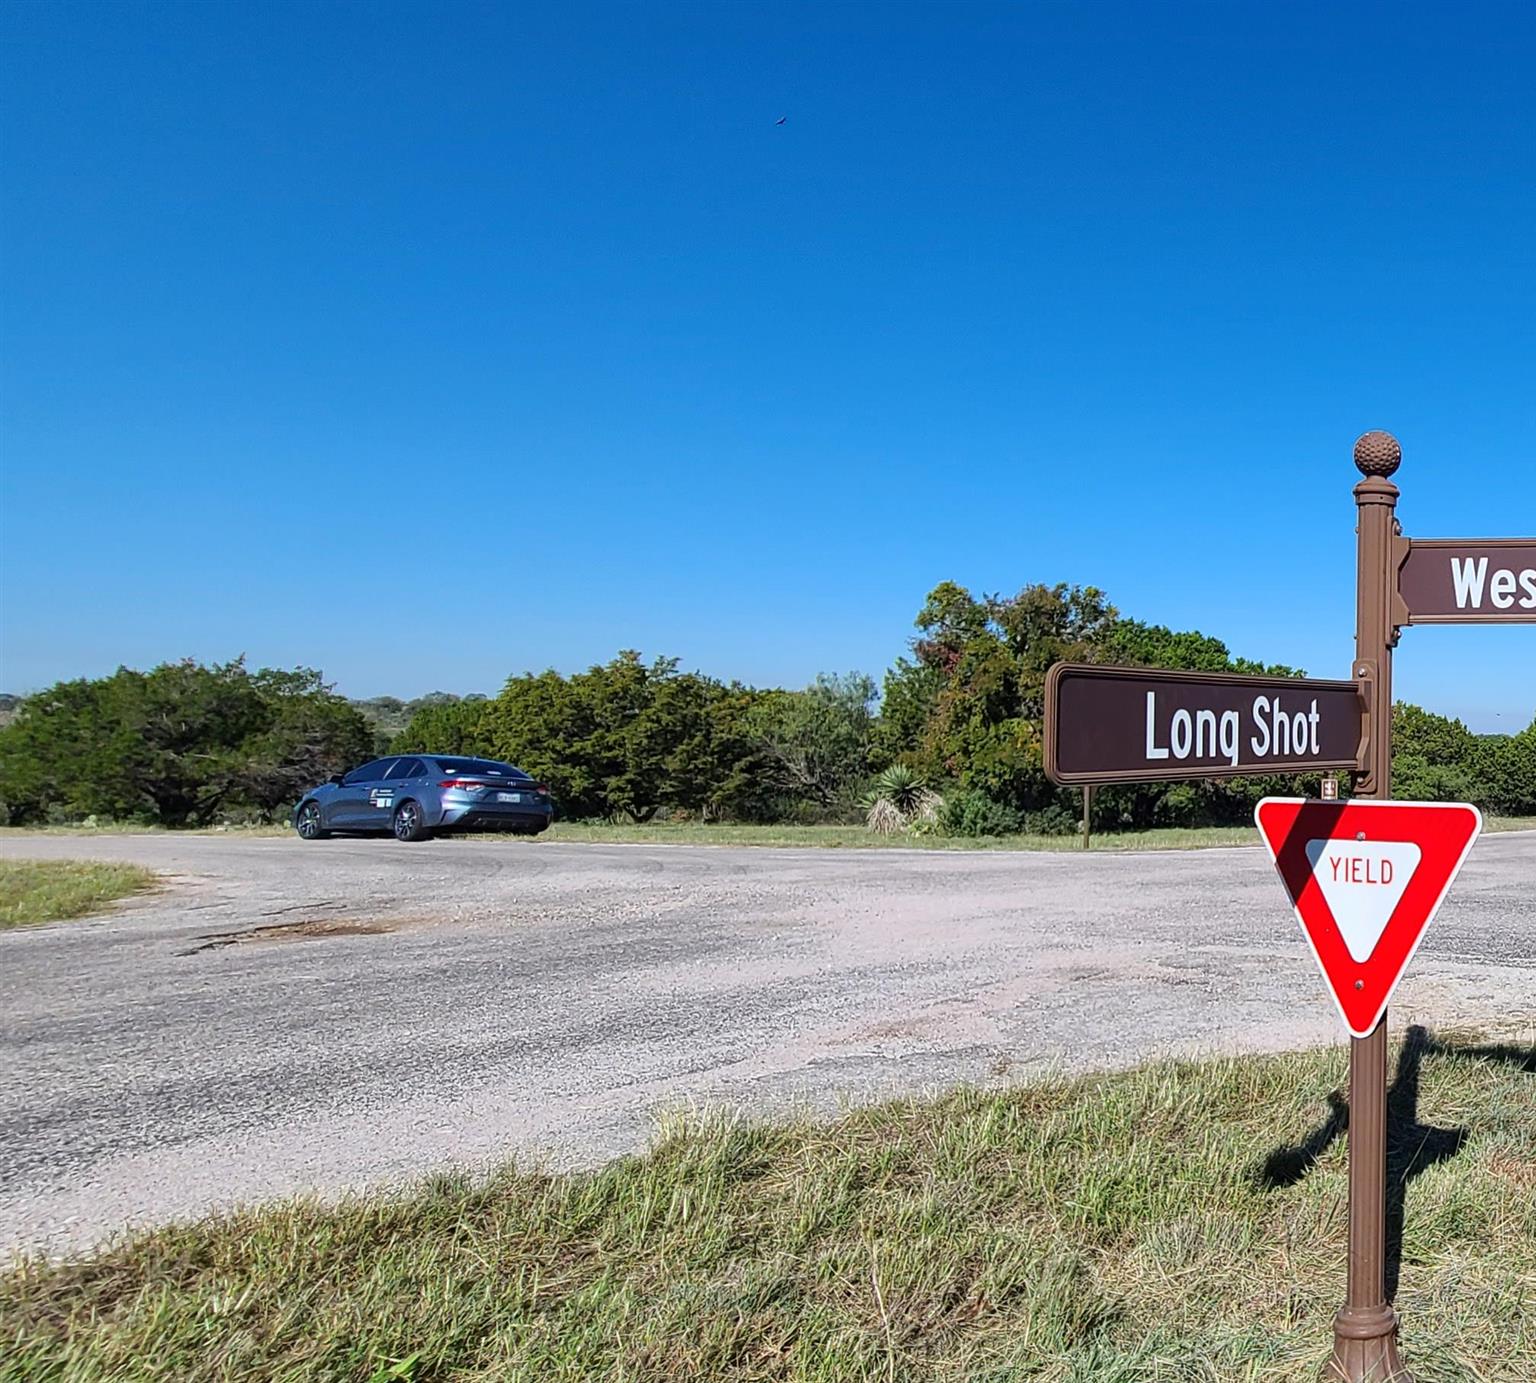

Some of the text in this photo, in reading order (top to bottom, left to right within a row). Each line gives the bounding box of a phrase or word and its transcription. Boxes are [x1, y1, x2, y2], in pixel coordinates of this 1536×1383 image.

[1145, 691, 1320, 768] Long Shot
[1330, 856, 1393, 885] YIELD
